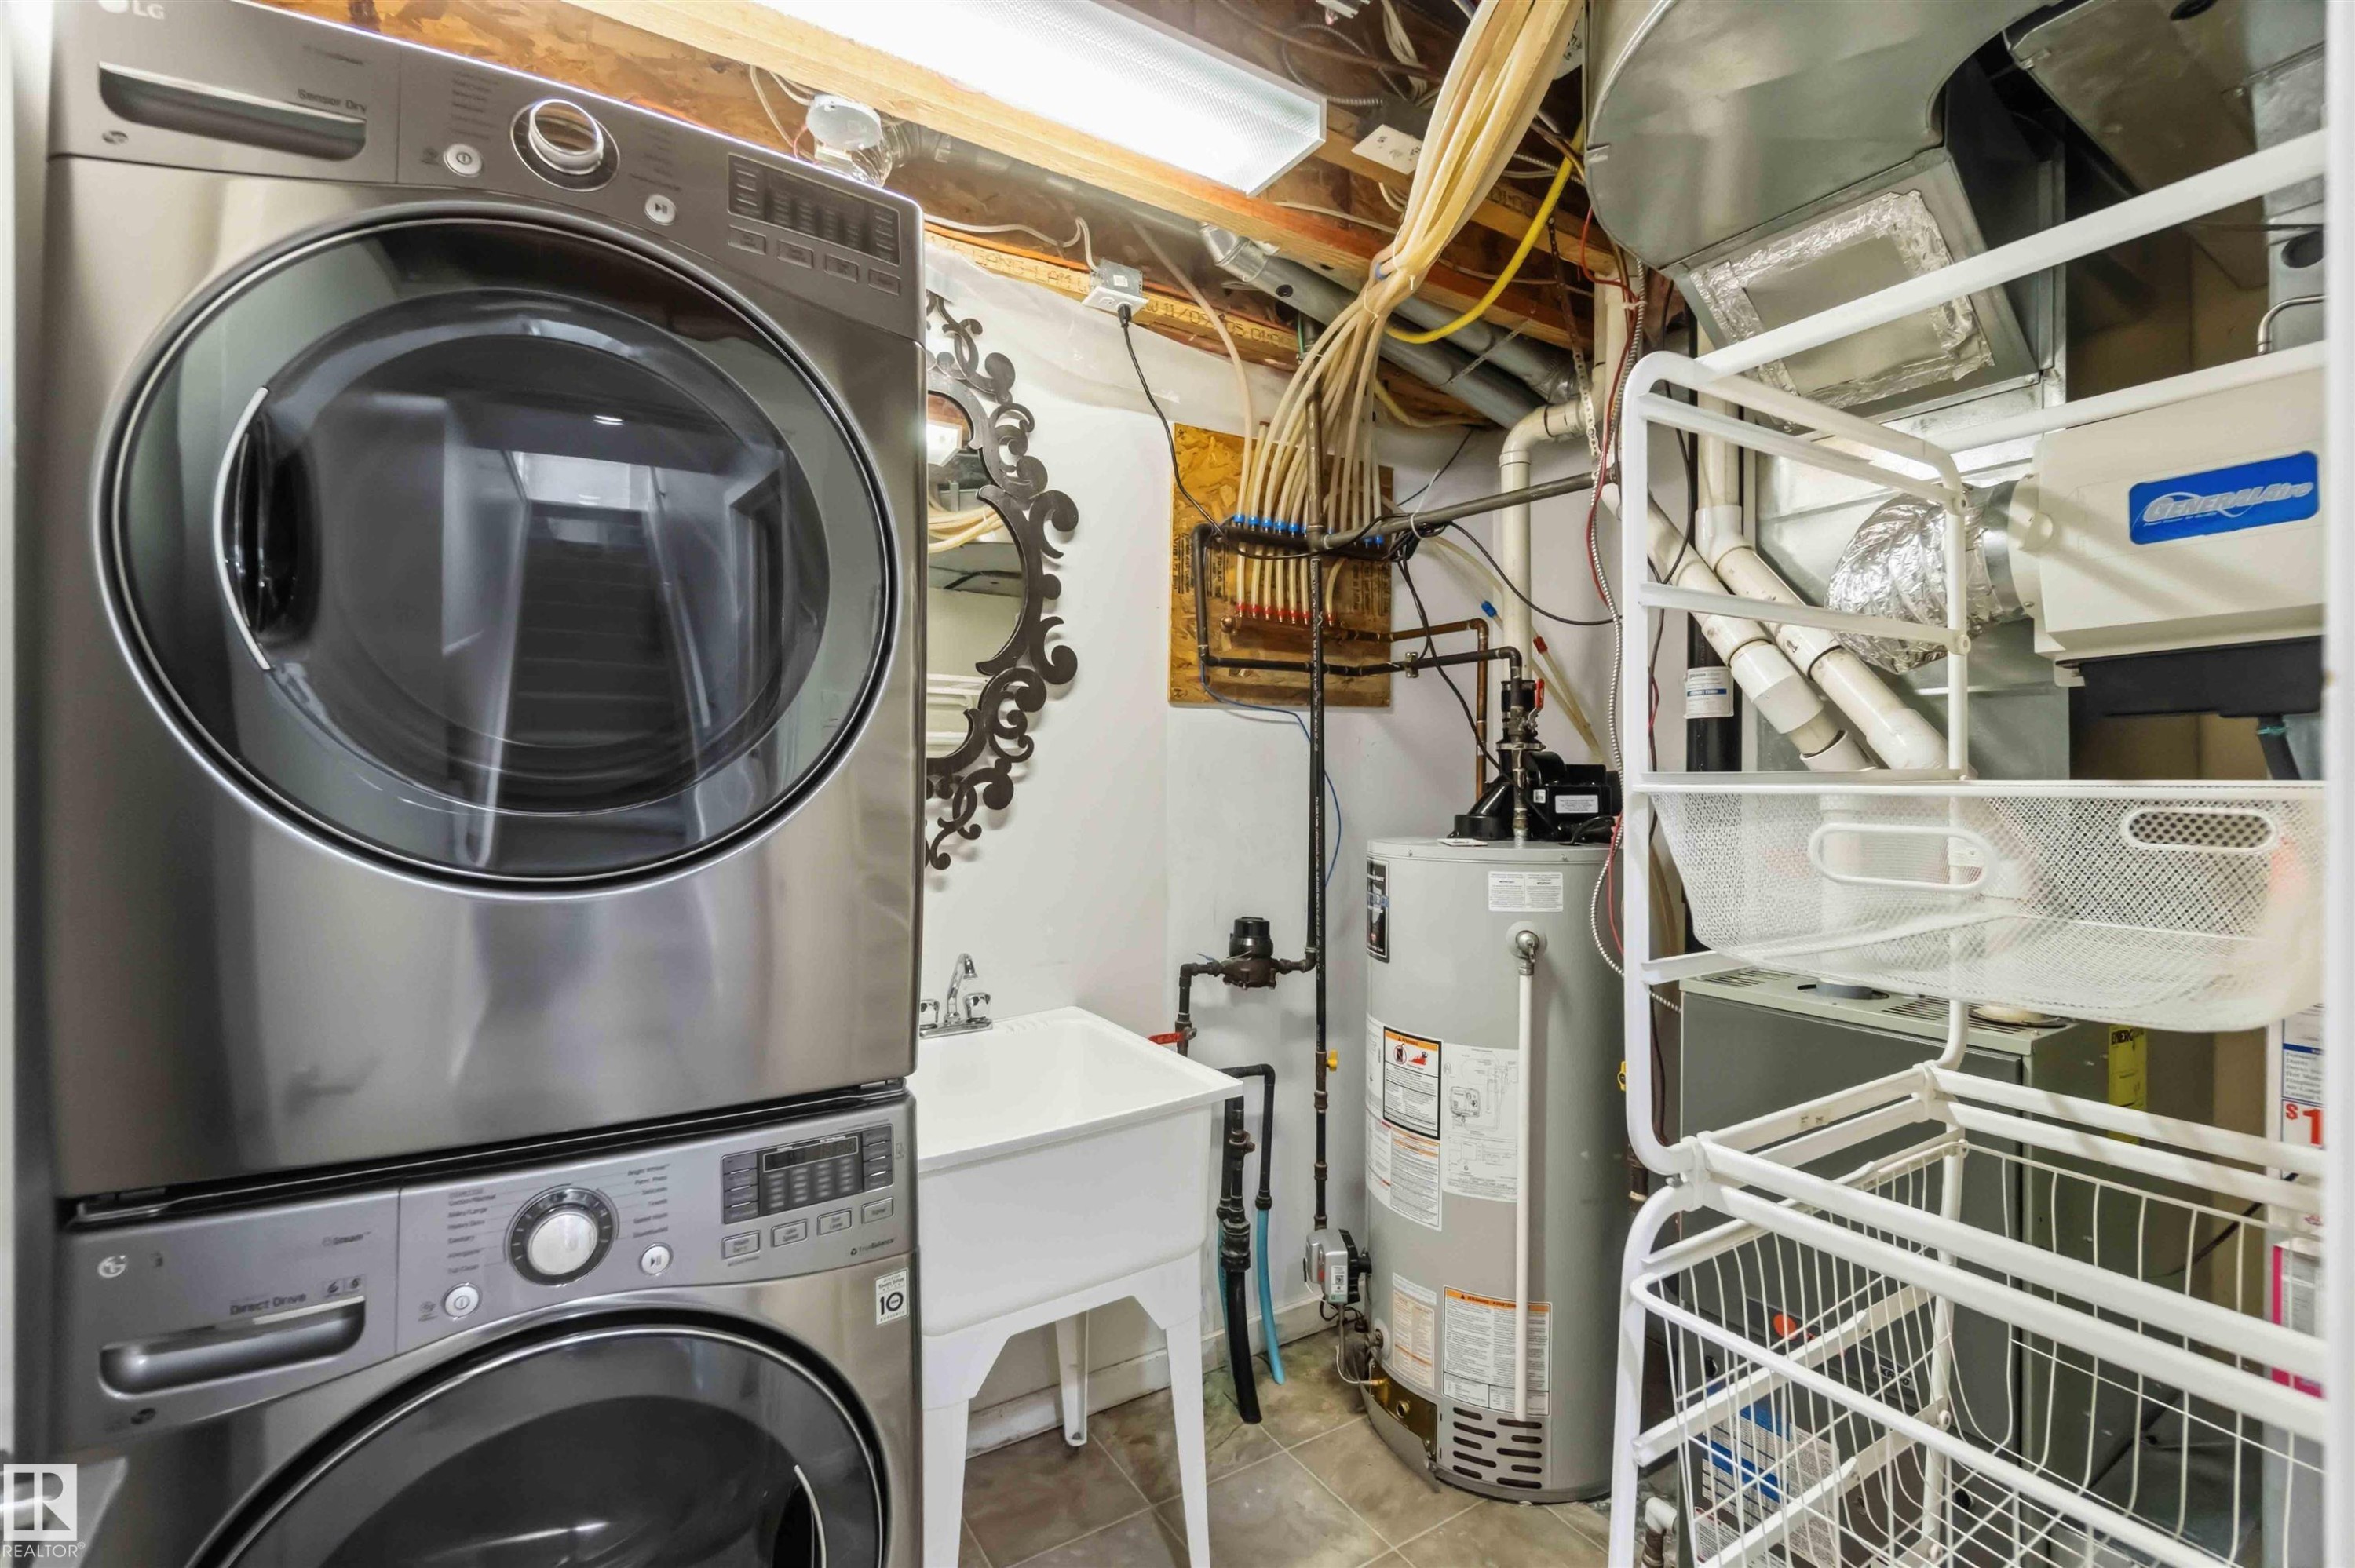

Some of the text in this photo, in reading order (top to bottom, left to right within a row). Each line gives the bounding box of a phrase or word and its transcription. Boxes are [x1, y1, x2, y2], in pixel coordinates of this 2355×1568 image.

[298, 89, 367, 114] Sensor Dry
[229, 1300, 270, 1316] Direct
[272, 1293, 307, 1307] Drive
